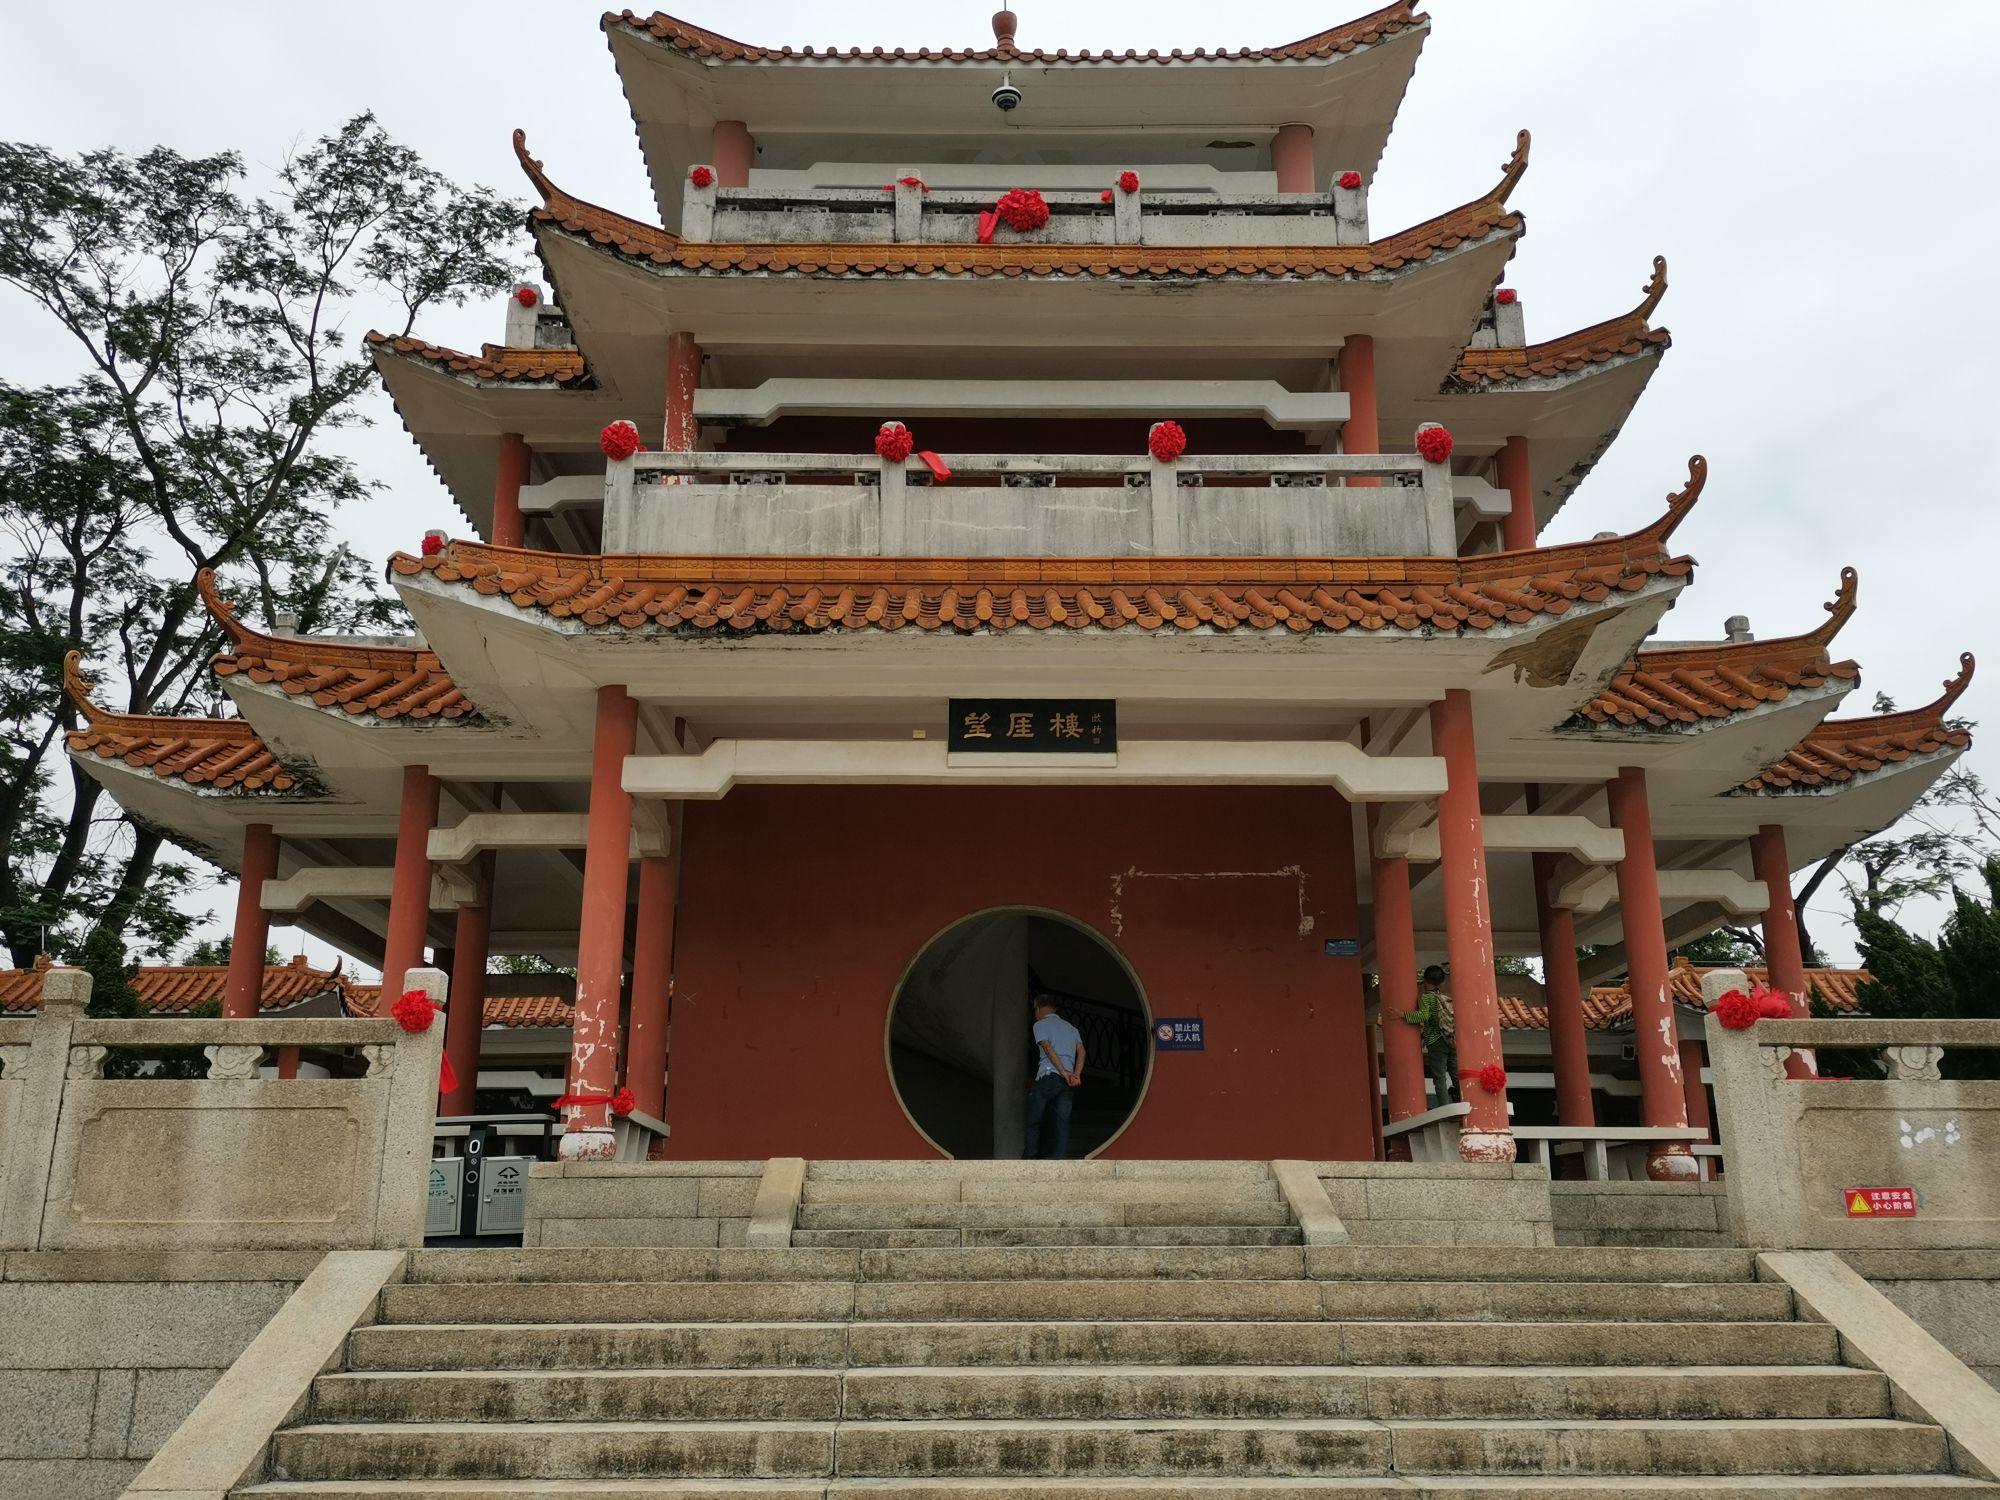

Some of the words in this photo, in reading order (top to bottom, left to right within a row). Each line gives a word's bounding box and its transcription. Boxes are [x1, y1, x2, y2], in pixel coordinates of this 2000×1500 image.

[1174, 1023, 1200, 1032] 禁止放
[1175, 1033, 1201, 1042] 无人机
[1871, 1191, 1911, 1200] 注意安全
[1873, 1201, 1913, 1210] 小心阶梯
